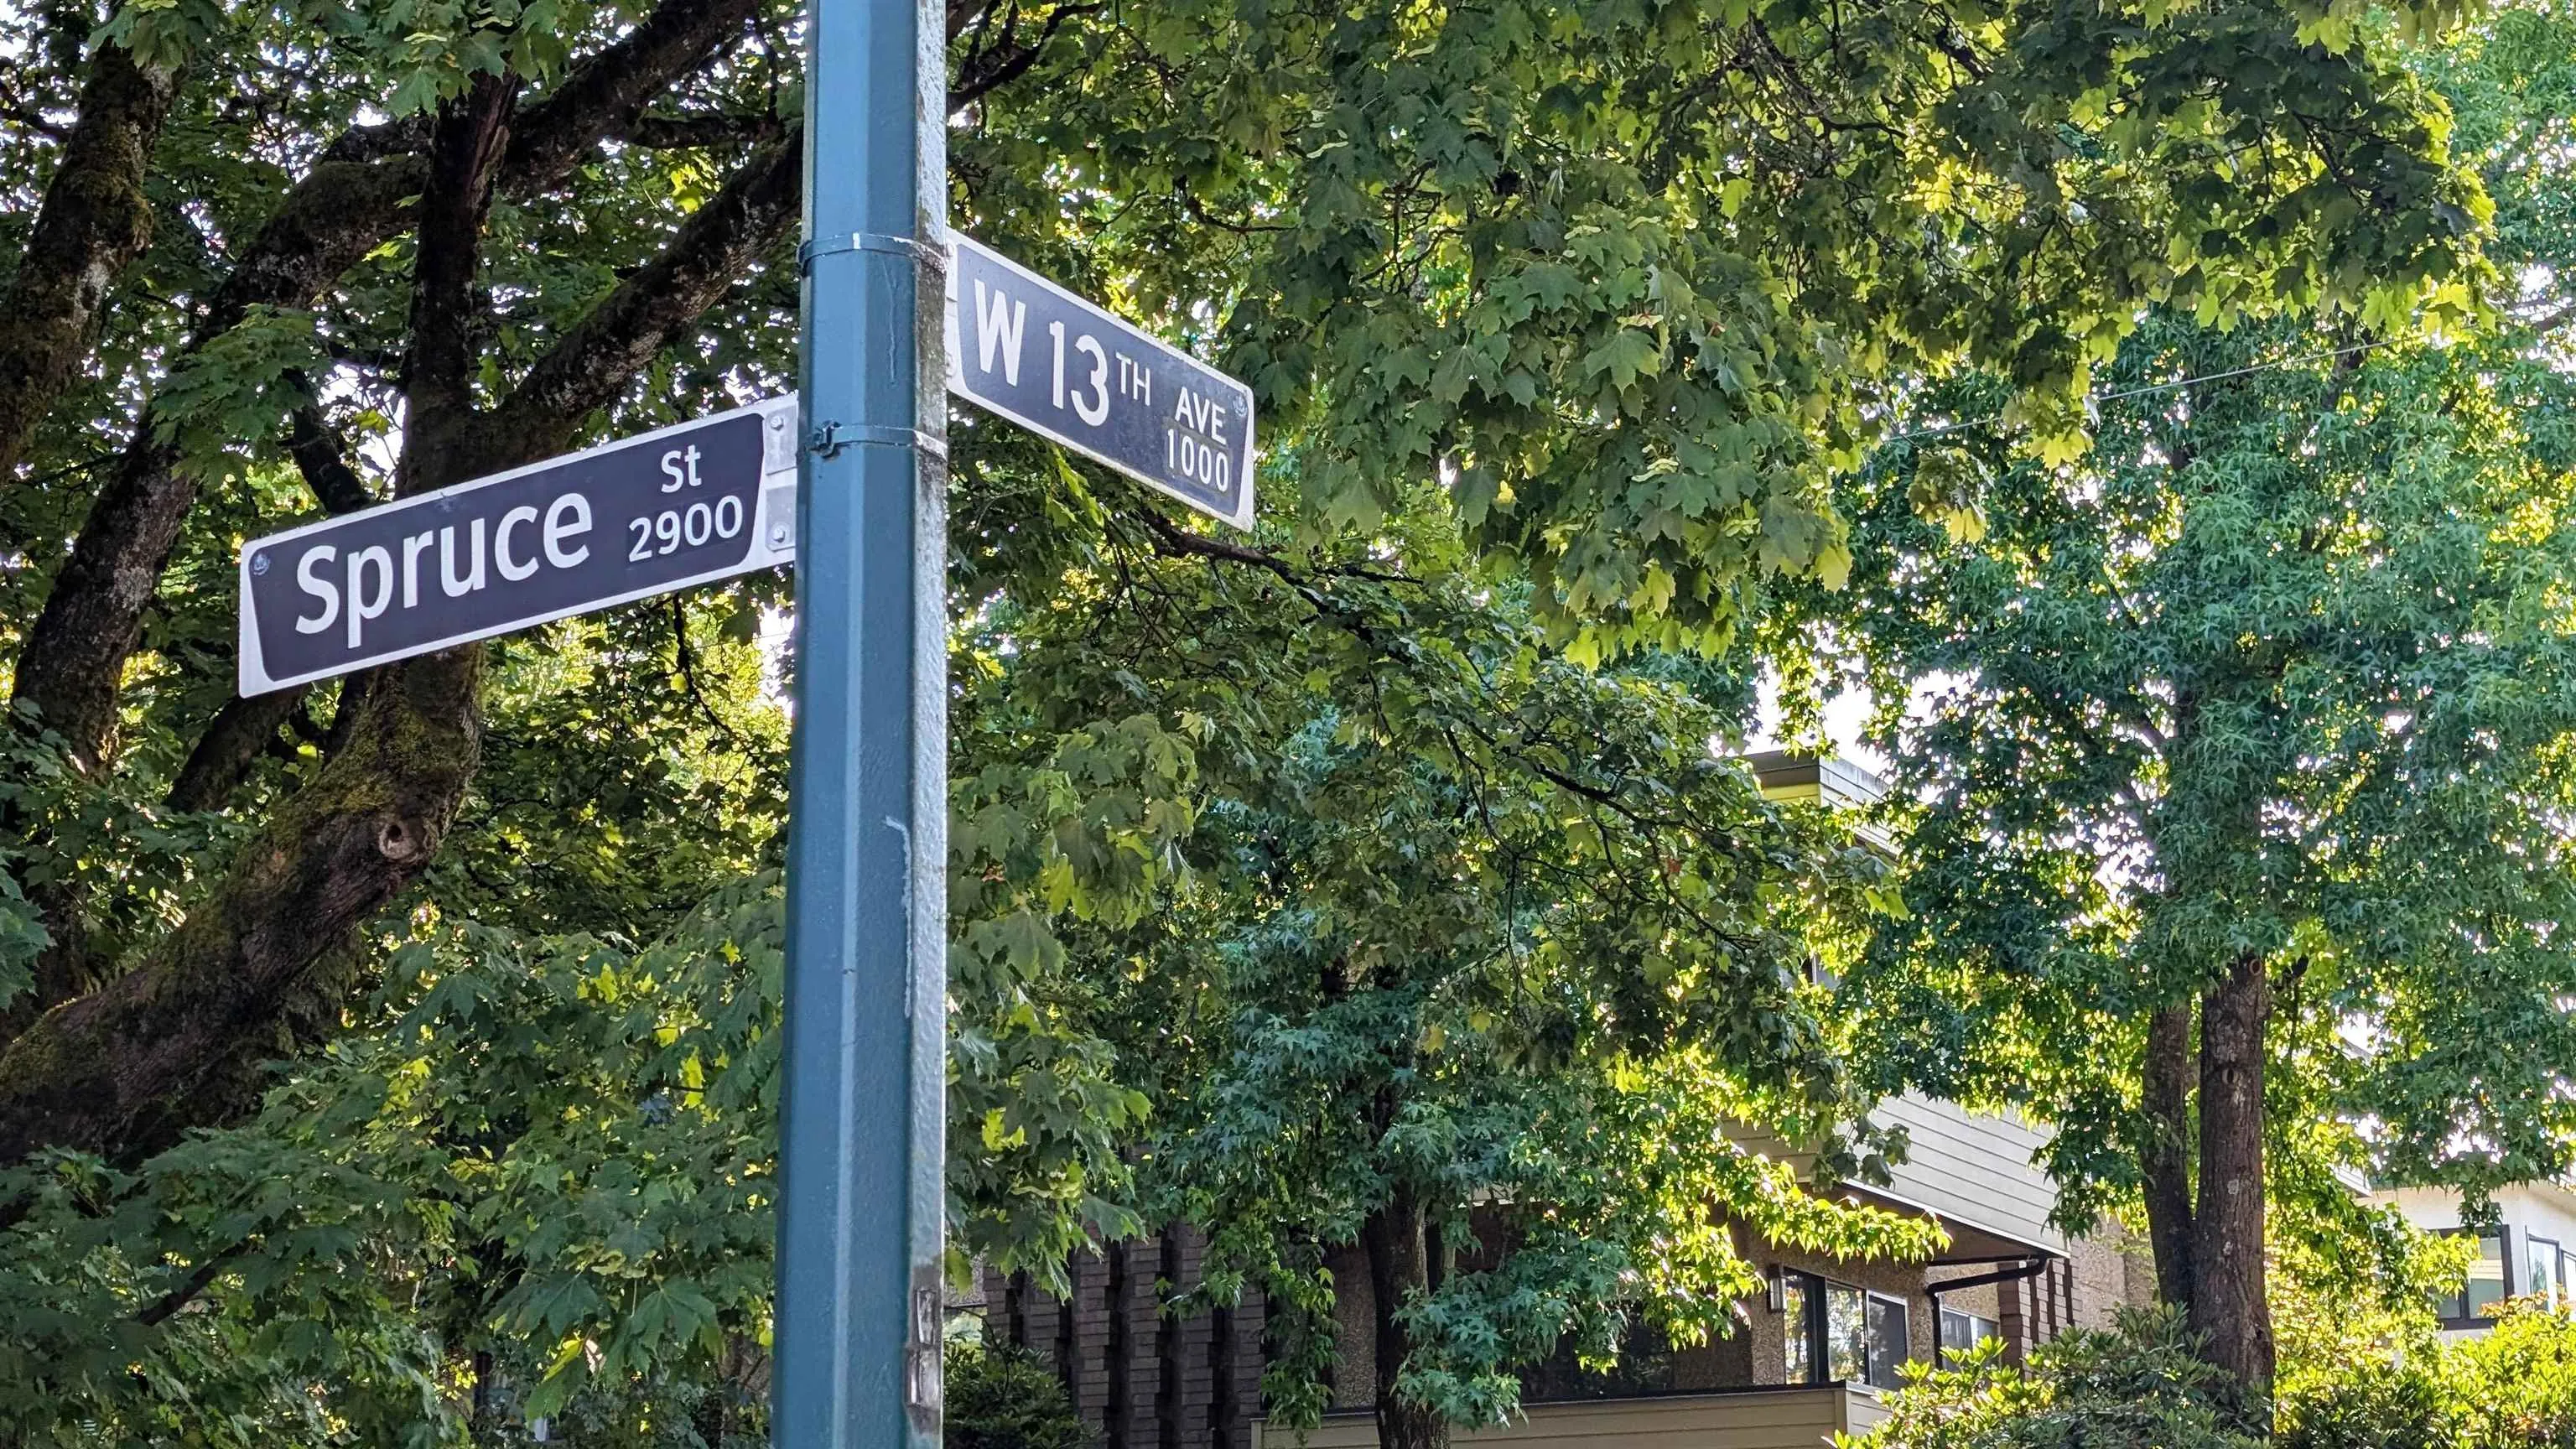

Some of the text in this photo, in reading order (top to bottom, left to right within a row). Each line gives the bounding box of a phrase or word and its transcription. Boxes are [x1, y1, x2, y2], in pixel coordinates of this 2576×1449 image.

[974, 278, 1228, 444] W 13TH AVE
[1166, 428, 1229, 493] 1000
[295, 444, 702, 649] Spruce St
[628, 495, 743, 563] 2900
